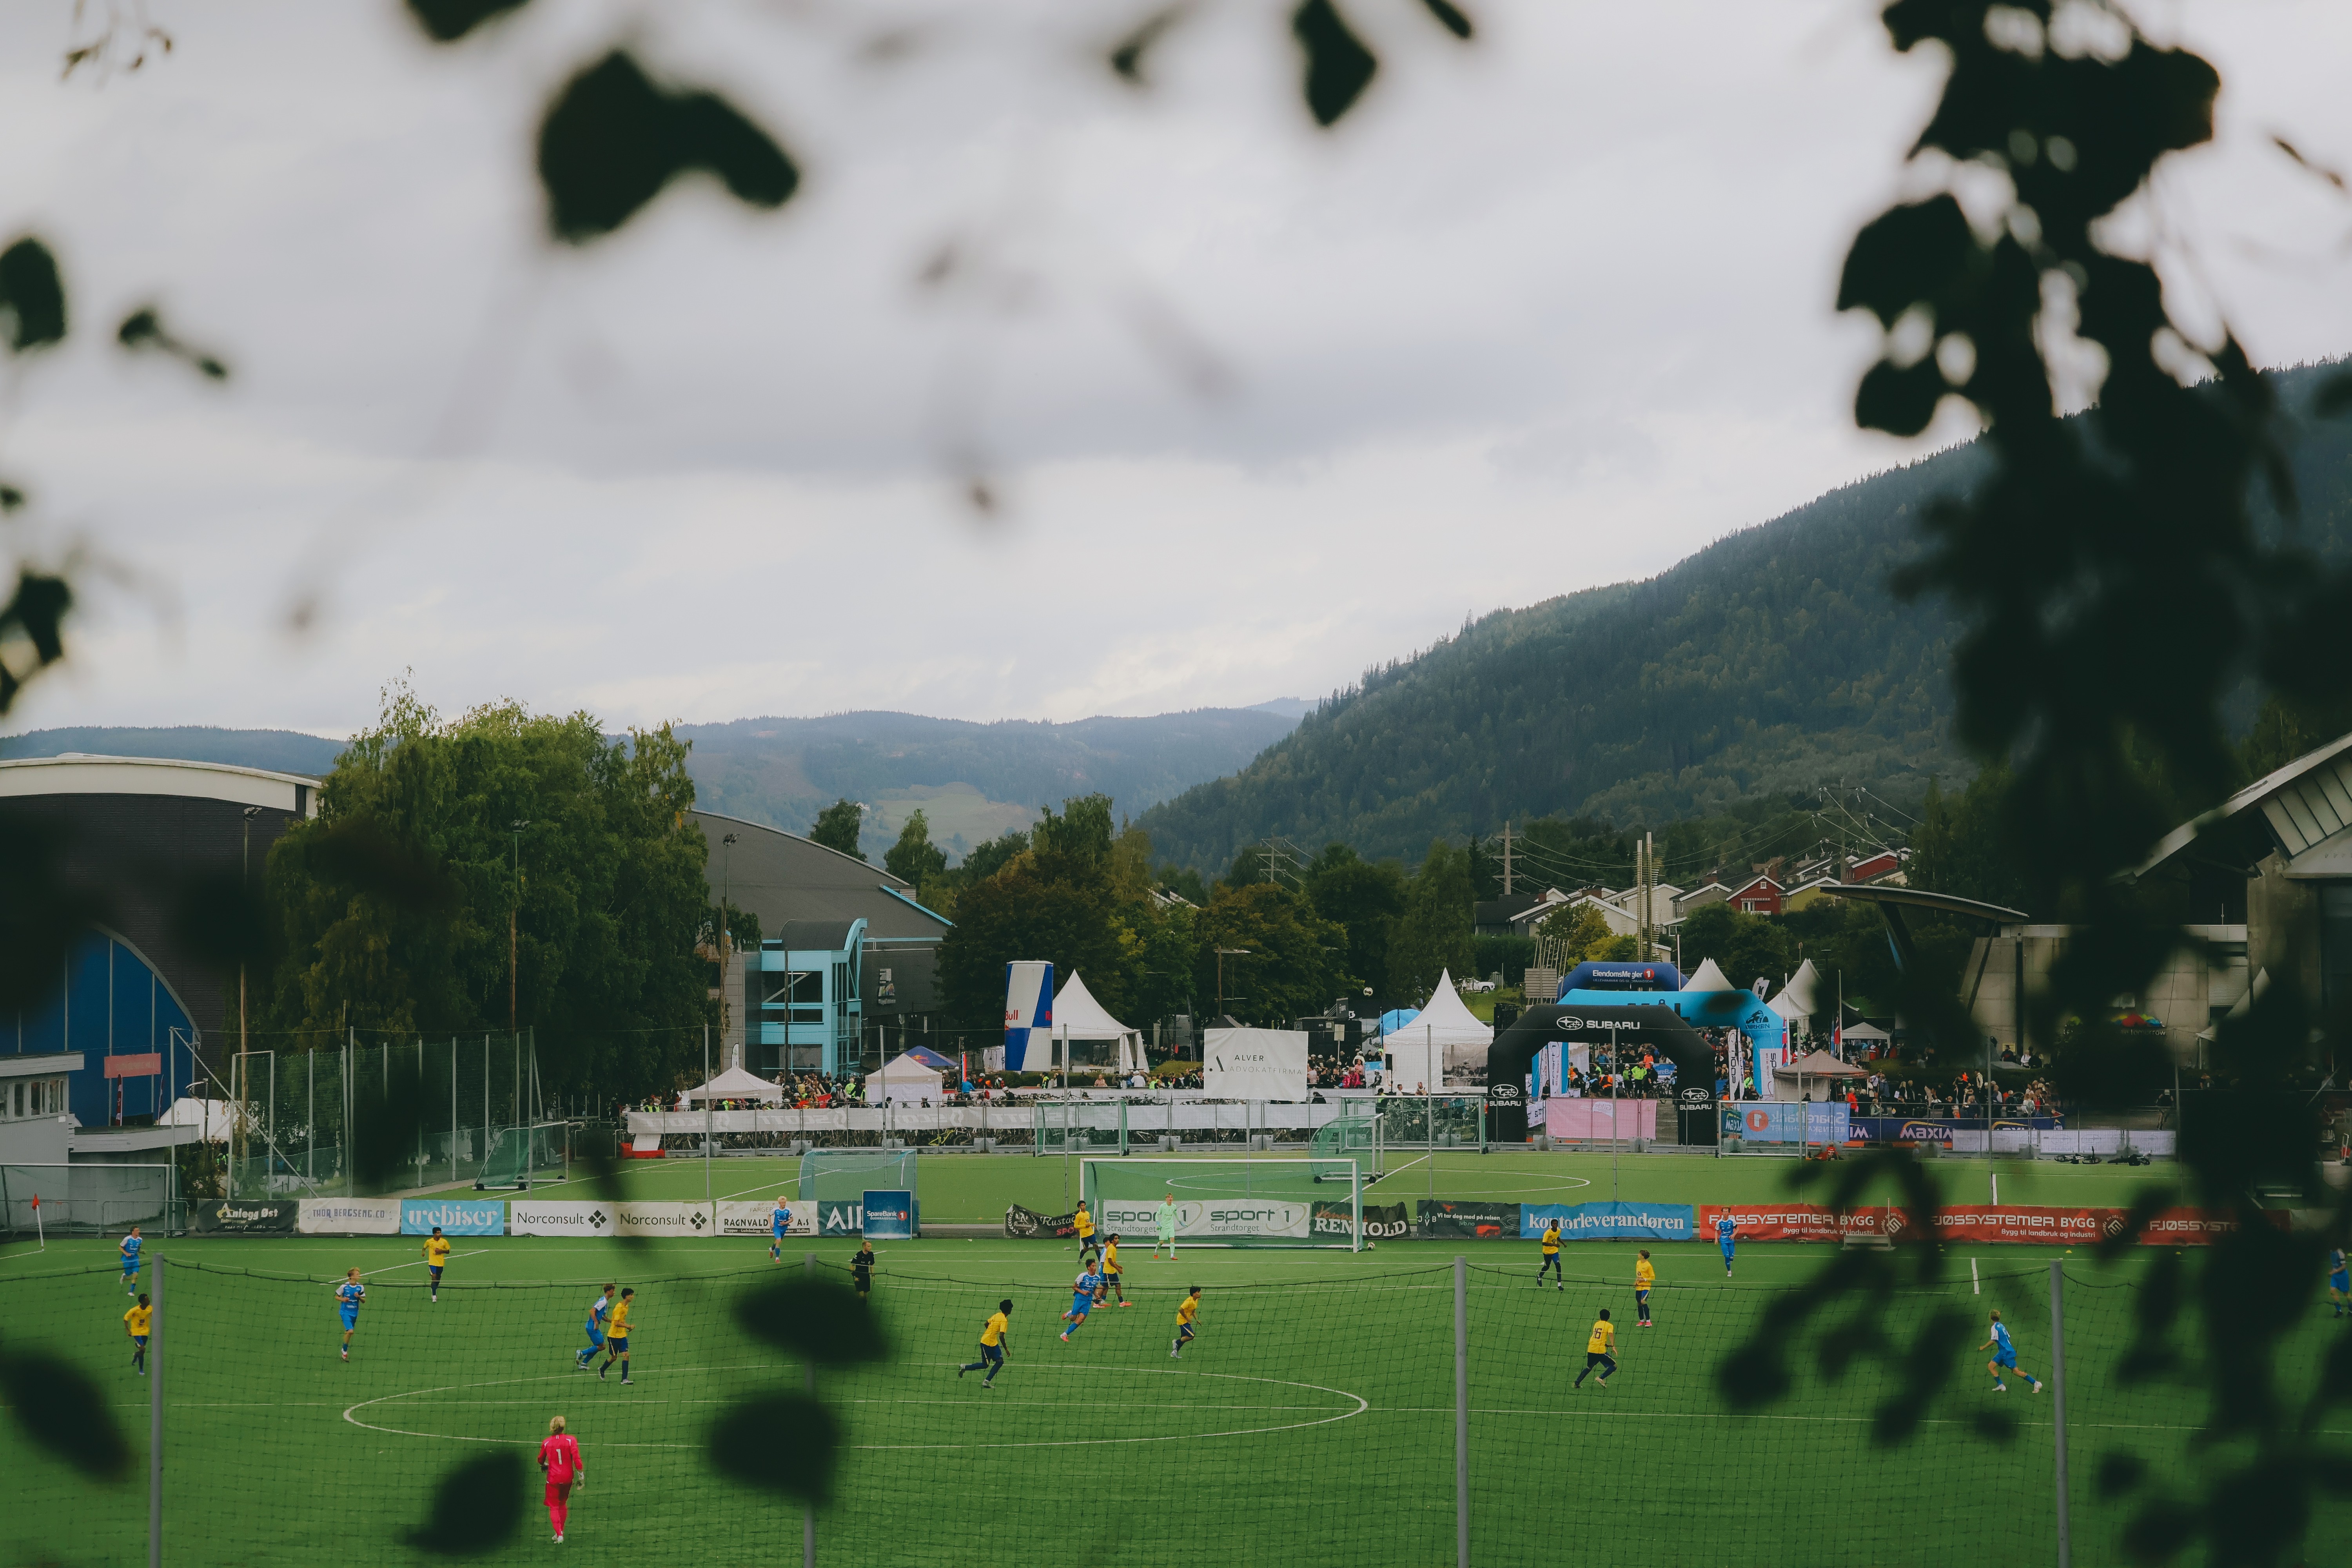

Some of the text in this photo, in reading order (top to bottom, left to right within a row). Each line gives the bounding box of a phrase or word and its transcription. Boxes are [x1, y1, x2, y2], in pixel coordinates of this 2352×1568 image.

[1593, 970, 1642, 979] EiendomsMegler
[1005, 1009, 1018, 1020] Bull
[1586, 1020, 1640, 1030] SUBARU
[1229, 1066, 1302, 1075] ADVOKATFIRMA
[220, 1203, 278, 1221] Anlegg Øst
[313, 1209, 331, 1218] THOR
[408, 1205, 497, 1226] webiser
[1106, 1209, 1186, 1225] spo 1
[1210, 1209, 1290, 1224] sport 1
[517, 1212, 584, 1224] Norconsult
[621, 1214, 686, 1225] Norconsult
[724, 1218, 768, 1227] RAGNVALD
[1709, 1214, 1874, 1226] FSSYSTEMER BYGG
[2061, 1217, 2095, 1228] BYGG
[1106, 1224, 1156, 1234] Strandtorget
[1210, 1224, 1259, 1233] Strandtorget
[1593, 1328, 1602, 1339] 16
[556, 1449, 562, 1465] 1
